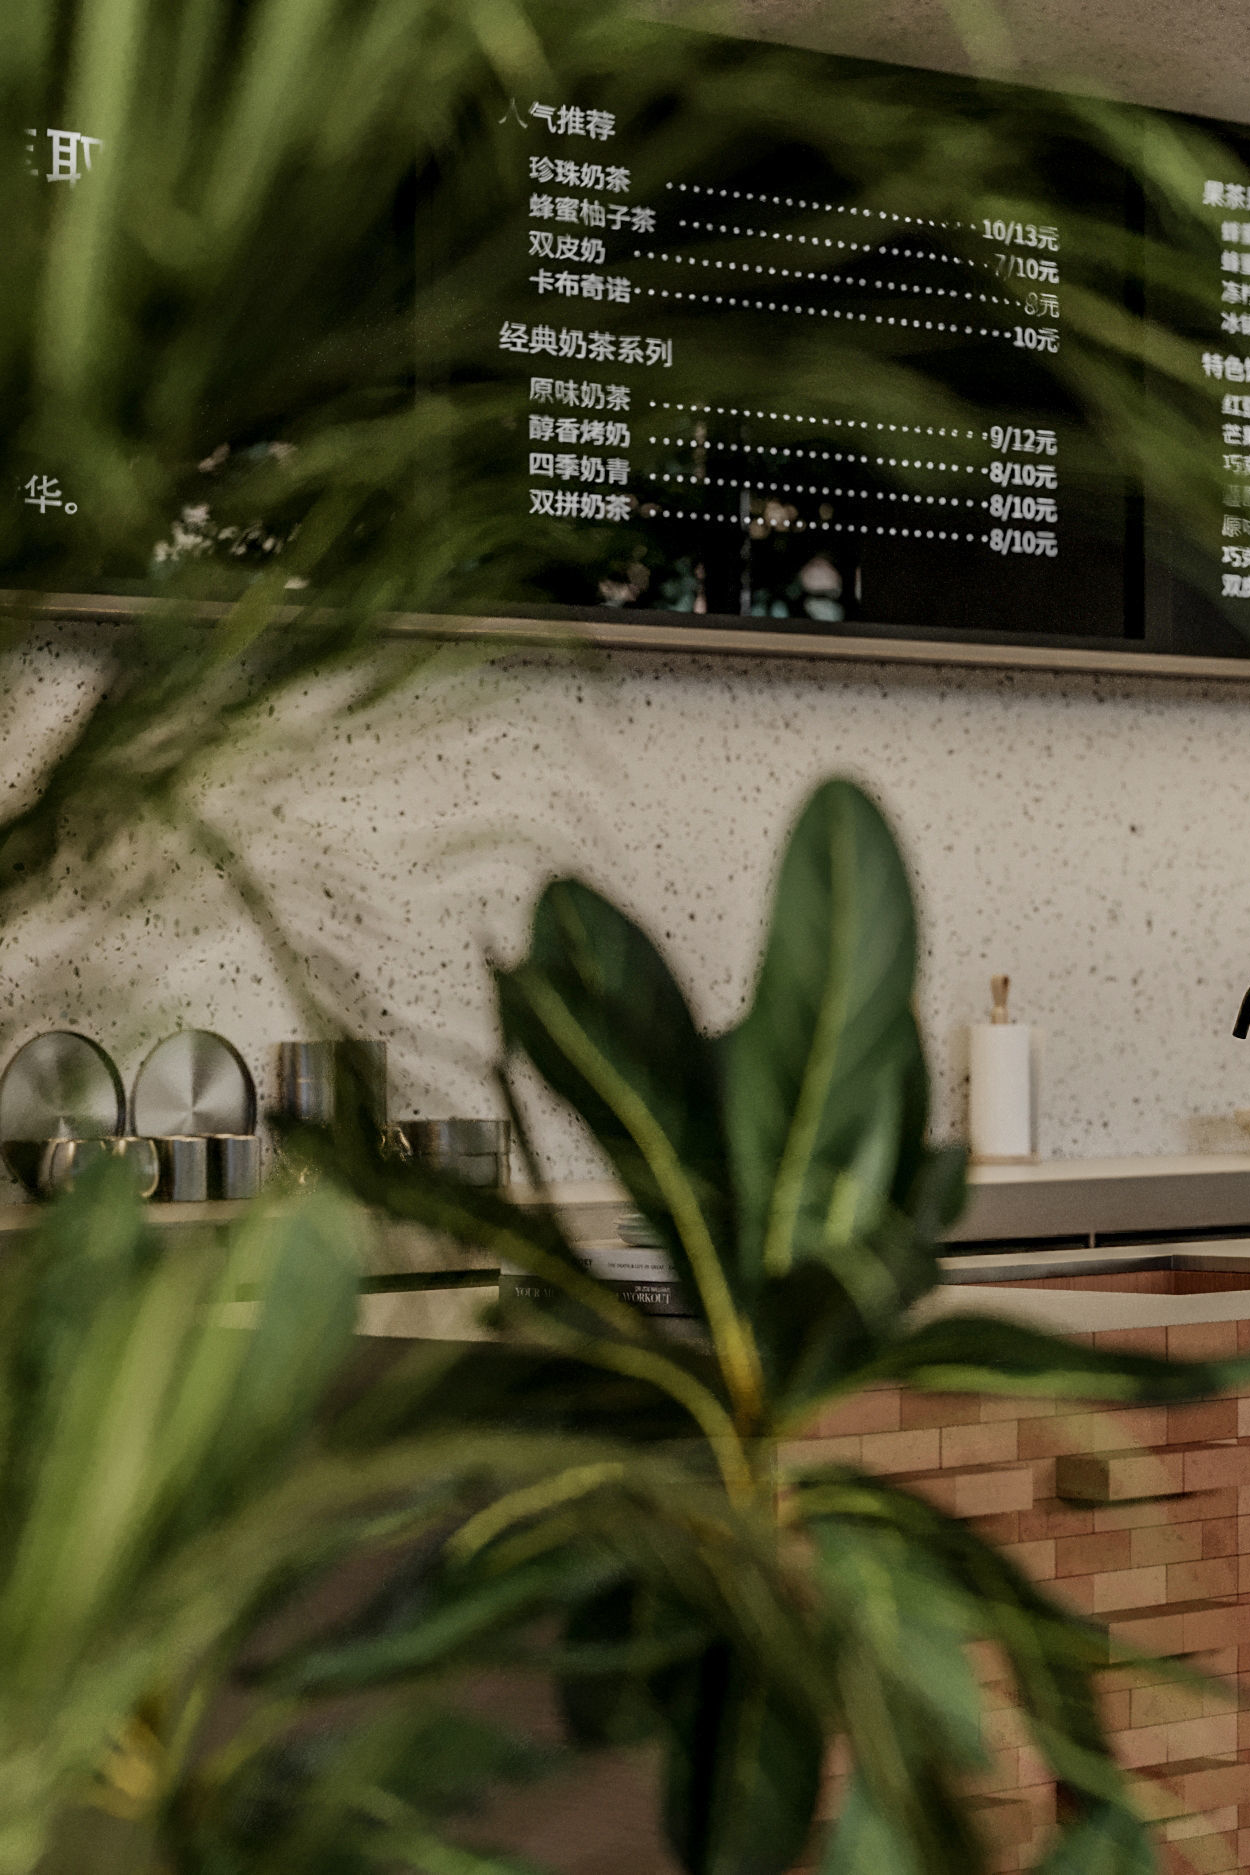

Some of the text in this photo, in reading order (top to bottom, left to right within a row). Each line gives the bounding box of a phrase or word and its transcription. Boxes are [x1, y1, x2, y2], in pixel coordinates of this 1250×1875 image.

[529, 155, 1060, 252] 珍珠奶茶 10/13元
[529, 192, 657, 234] 蜂蜜柚子茶
[528, 229, 606, 265] 双皮奶
[498, 320, 673, 368] 经典奶茶系列
[528, 267, 1060, 353] 卡布奇诺 10元
[529, 376, 1058, 456] 原味奶茶 9/12元
[528, 413, 1059, 490] 醇香烤奶 8/10元
[528, 452, 1059, 524] 四季奶青 8/10元
[529, 489, 1059, 558] 双拼奶茶 8/10元
[622, 1291, 672, 1305] WORKOUT
